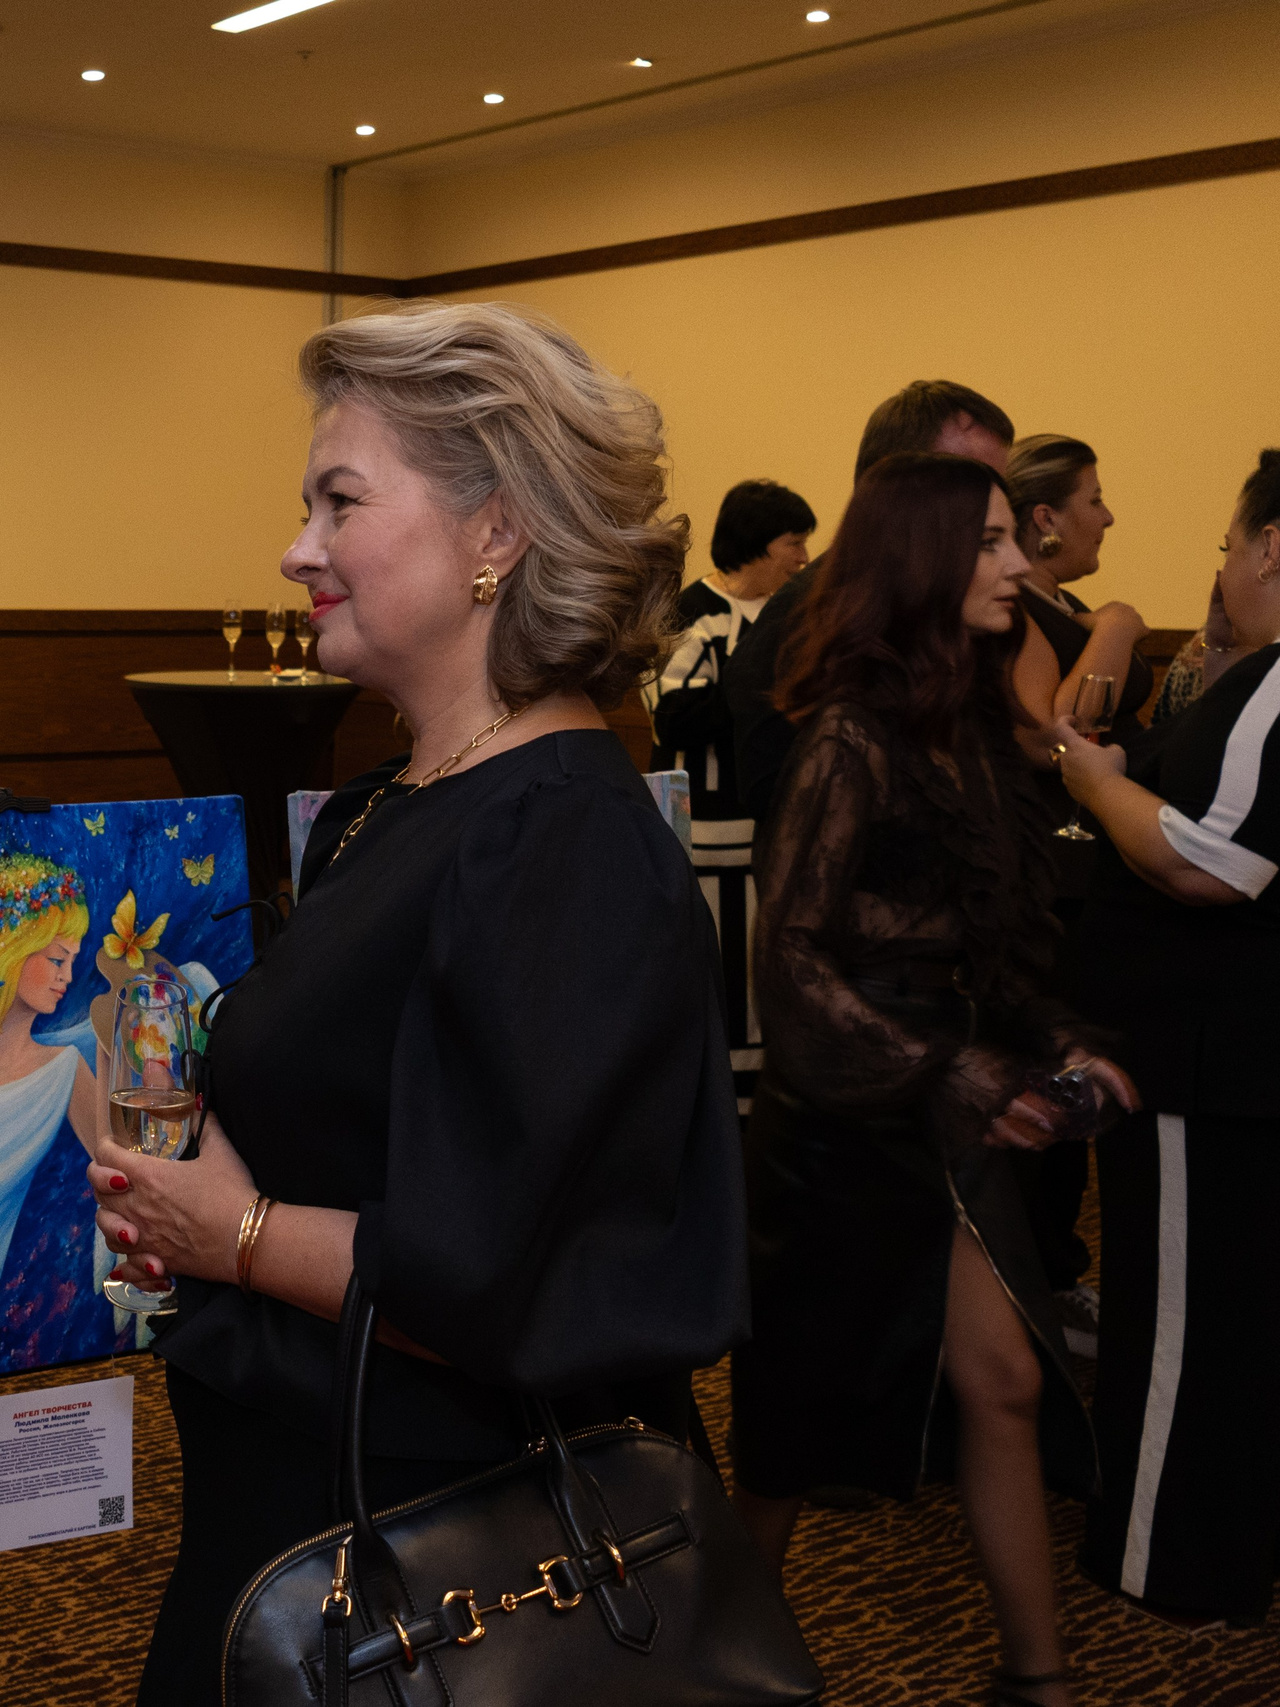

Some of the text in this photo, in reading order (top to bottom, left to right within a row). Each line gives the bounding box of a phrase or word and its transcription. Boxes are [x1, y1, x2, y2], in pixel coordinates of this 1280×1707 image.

[12, 1400, 93, 1421] АНГЕЛ ТВОРЧЕСТВА
[14, 1410, 91, 1429] Людмила Маленкова
[19, 1418, 86, 1434] Россия, Железногорск
